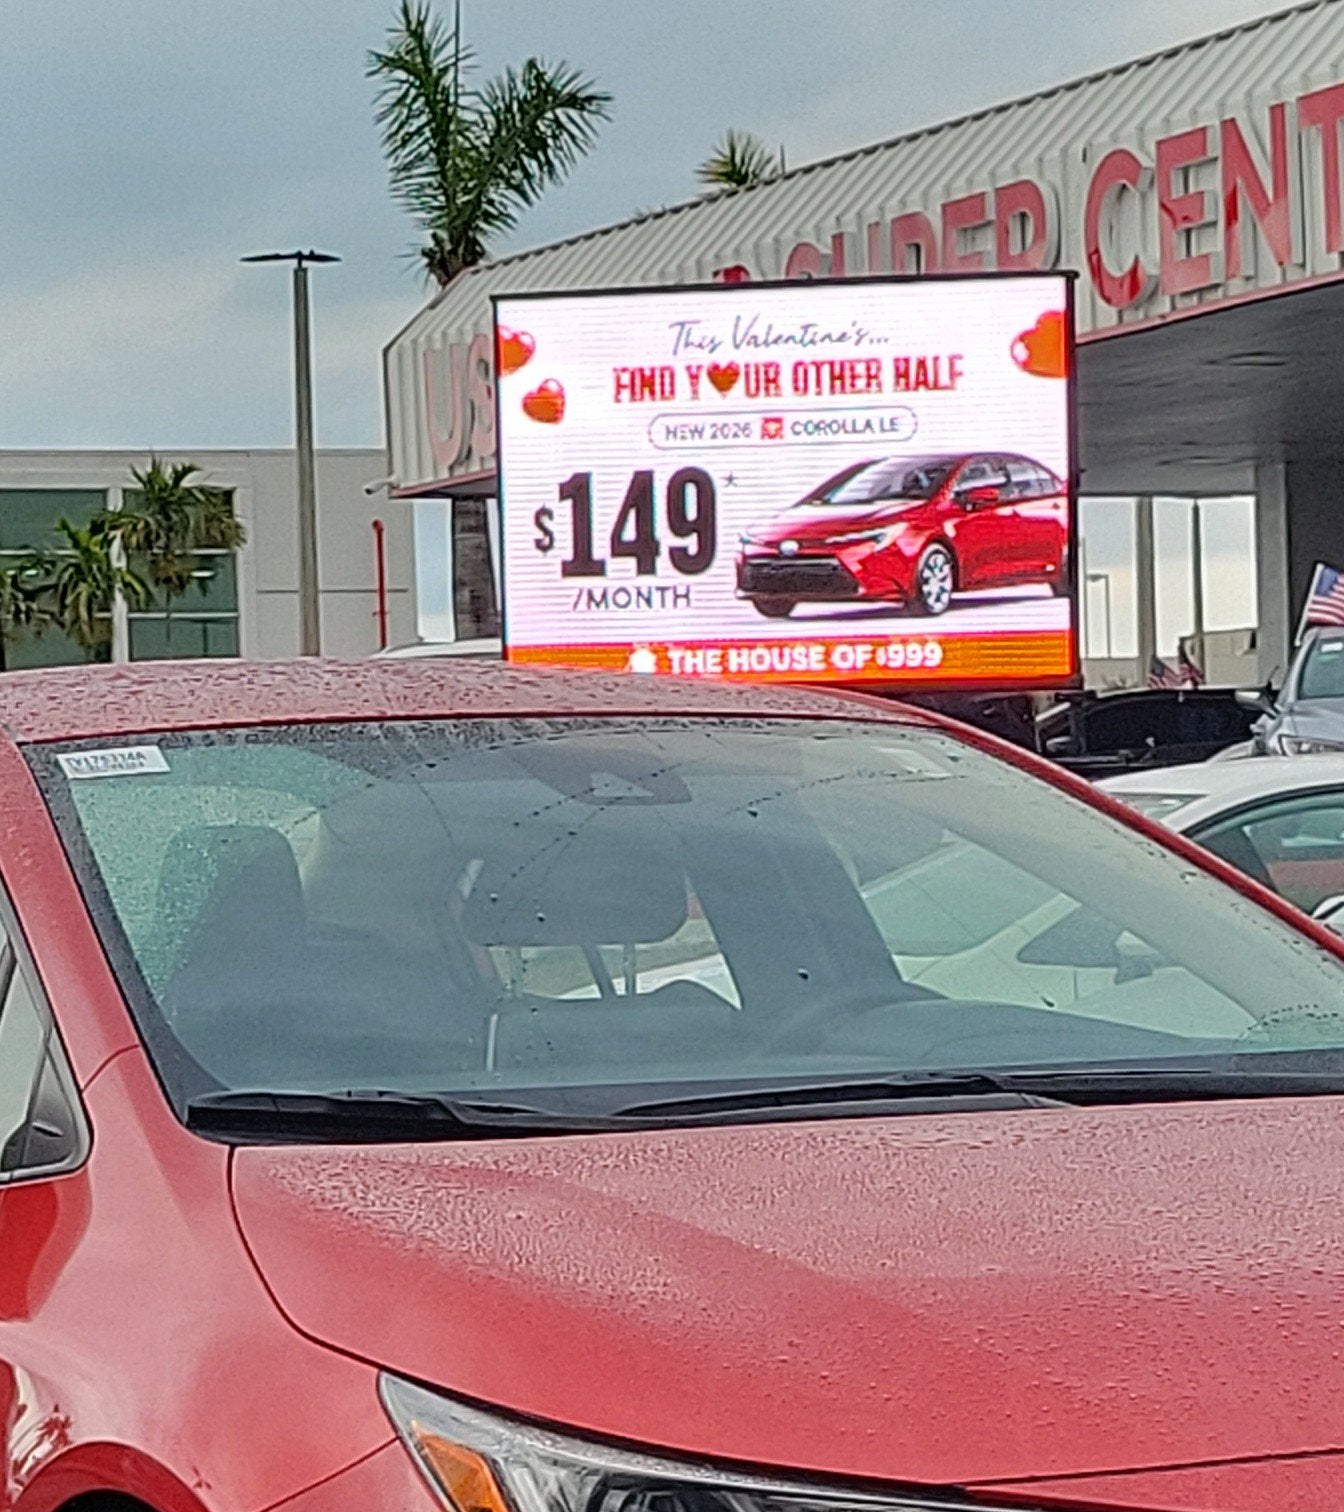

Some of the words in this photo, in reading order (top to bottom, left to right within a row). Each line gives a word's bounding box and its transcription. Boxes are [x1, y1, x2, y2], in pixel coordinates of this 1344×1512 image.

[669, 320, 722, 355] This
[613, 366, 676, 402] FIND
[792, 358, 883, 395] OTHER
[894, 354, 964, 391] HALF
[665, 425, 706, 441] NEW
[791, 419, 874, 437] COROLLA
[879, 417, 900, 433] LE
[573, 585, 692, 611] /MONTH
[667, 649, 723, 674] THE
[728, 647, 825, 672] HOUSE
[831, 645, 873, 668] OF
